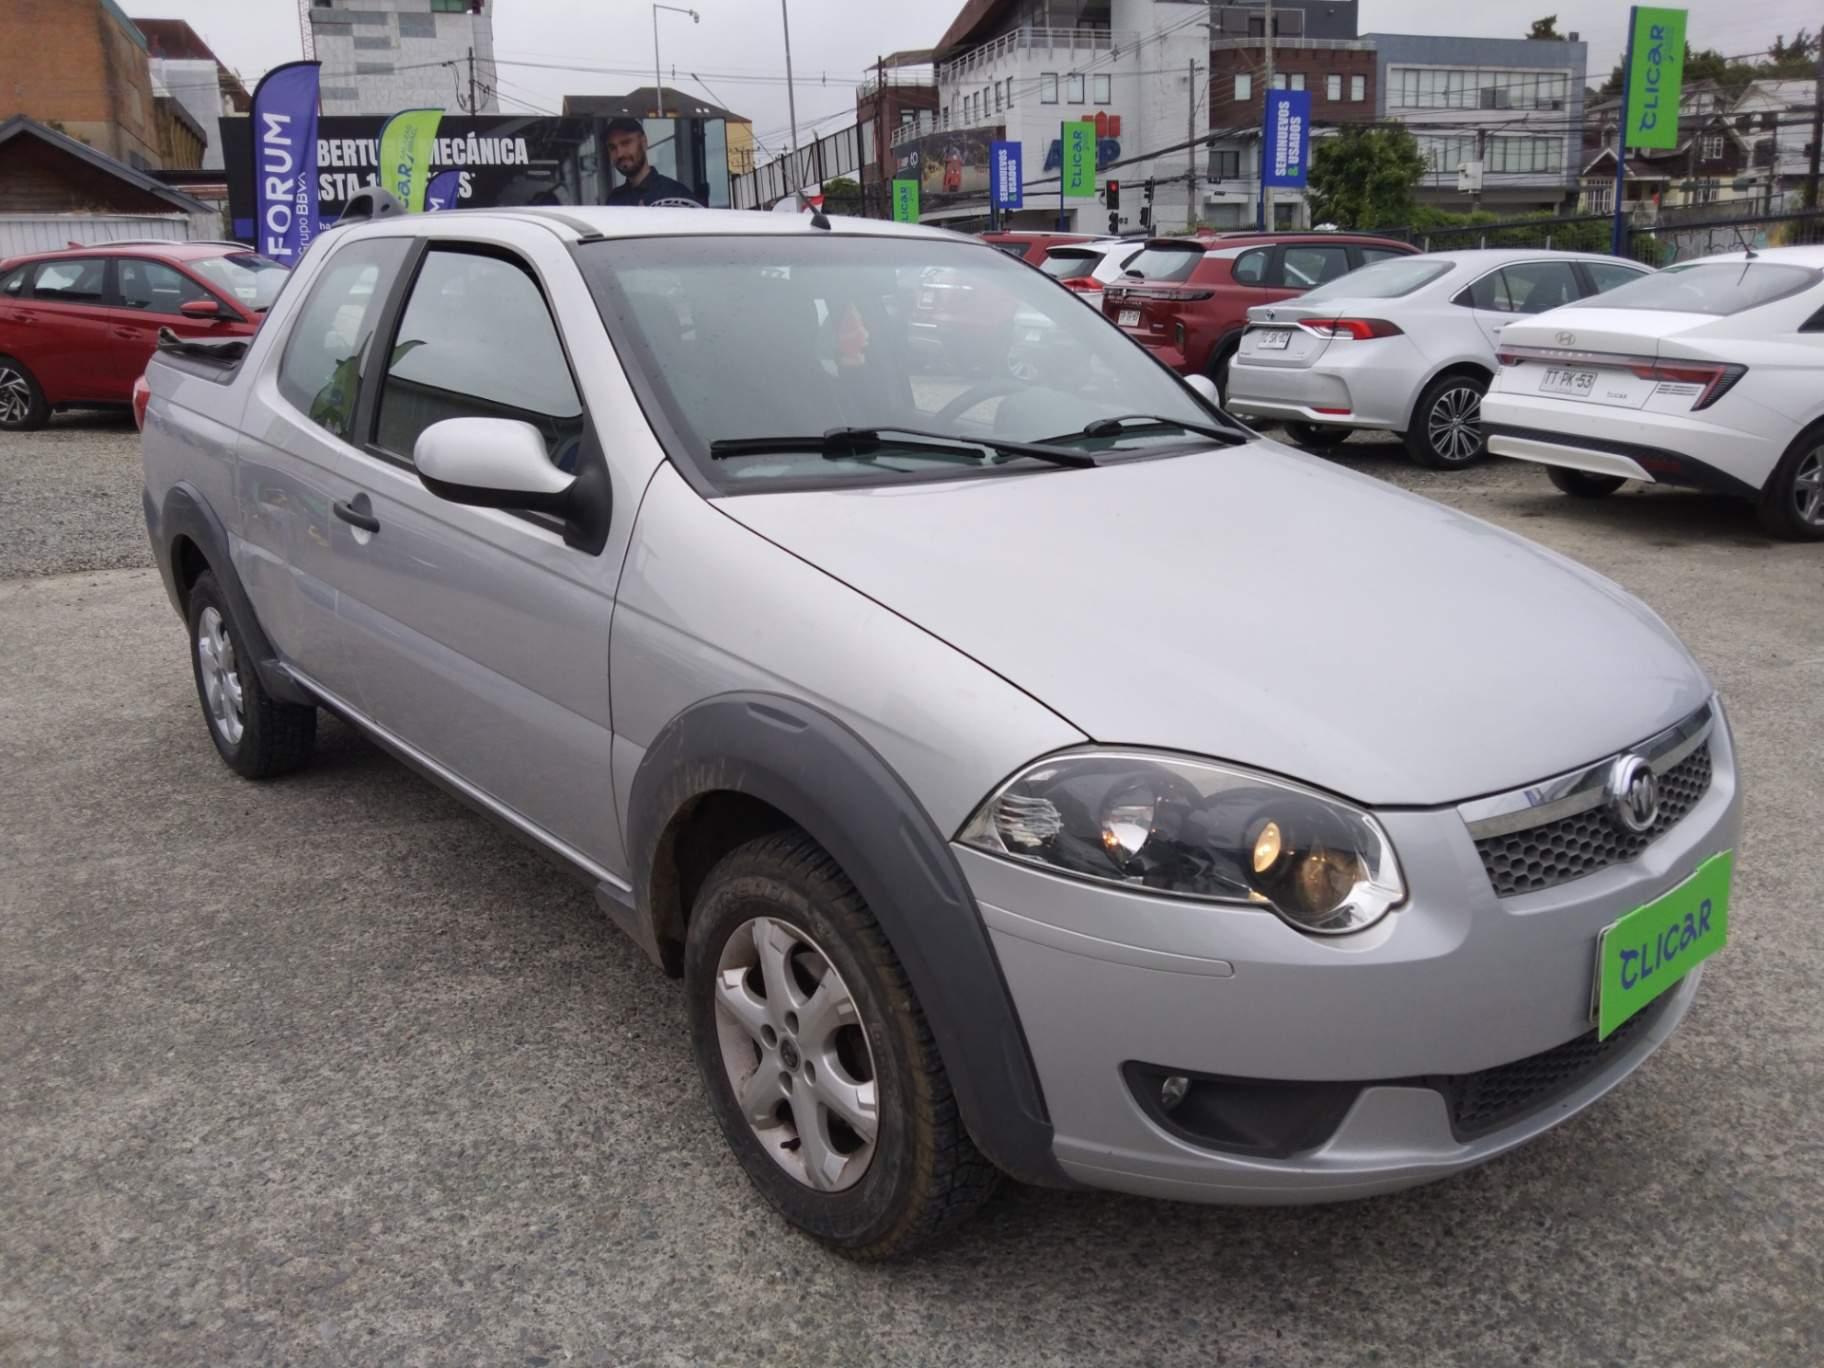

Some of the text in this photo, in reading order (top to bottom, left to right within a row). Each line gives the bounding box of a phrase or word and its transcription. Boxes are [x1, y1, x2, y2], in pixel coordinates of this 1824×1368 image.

[1275, 101, 1290, 177] SEMINUEVOS
[1287, 116, 1301, 165] USADOS
[262, 112, 294, 256] FORUM
[295, 172, 309, 216] BBVA
